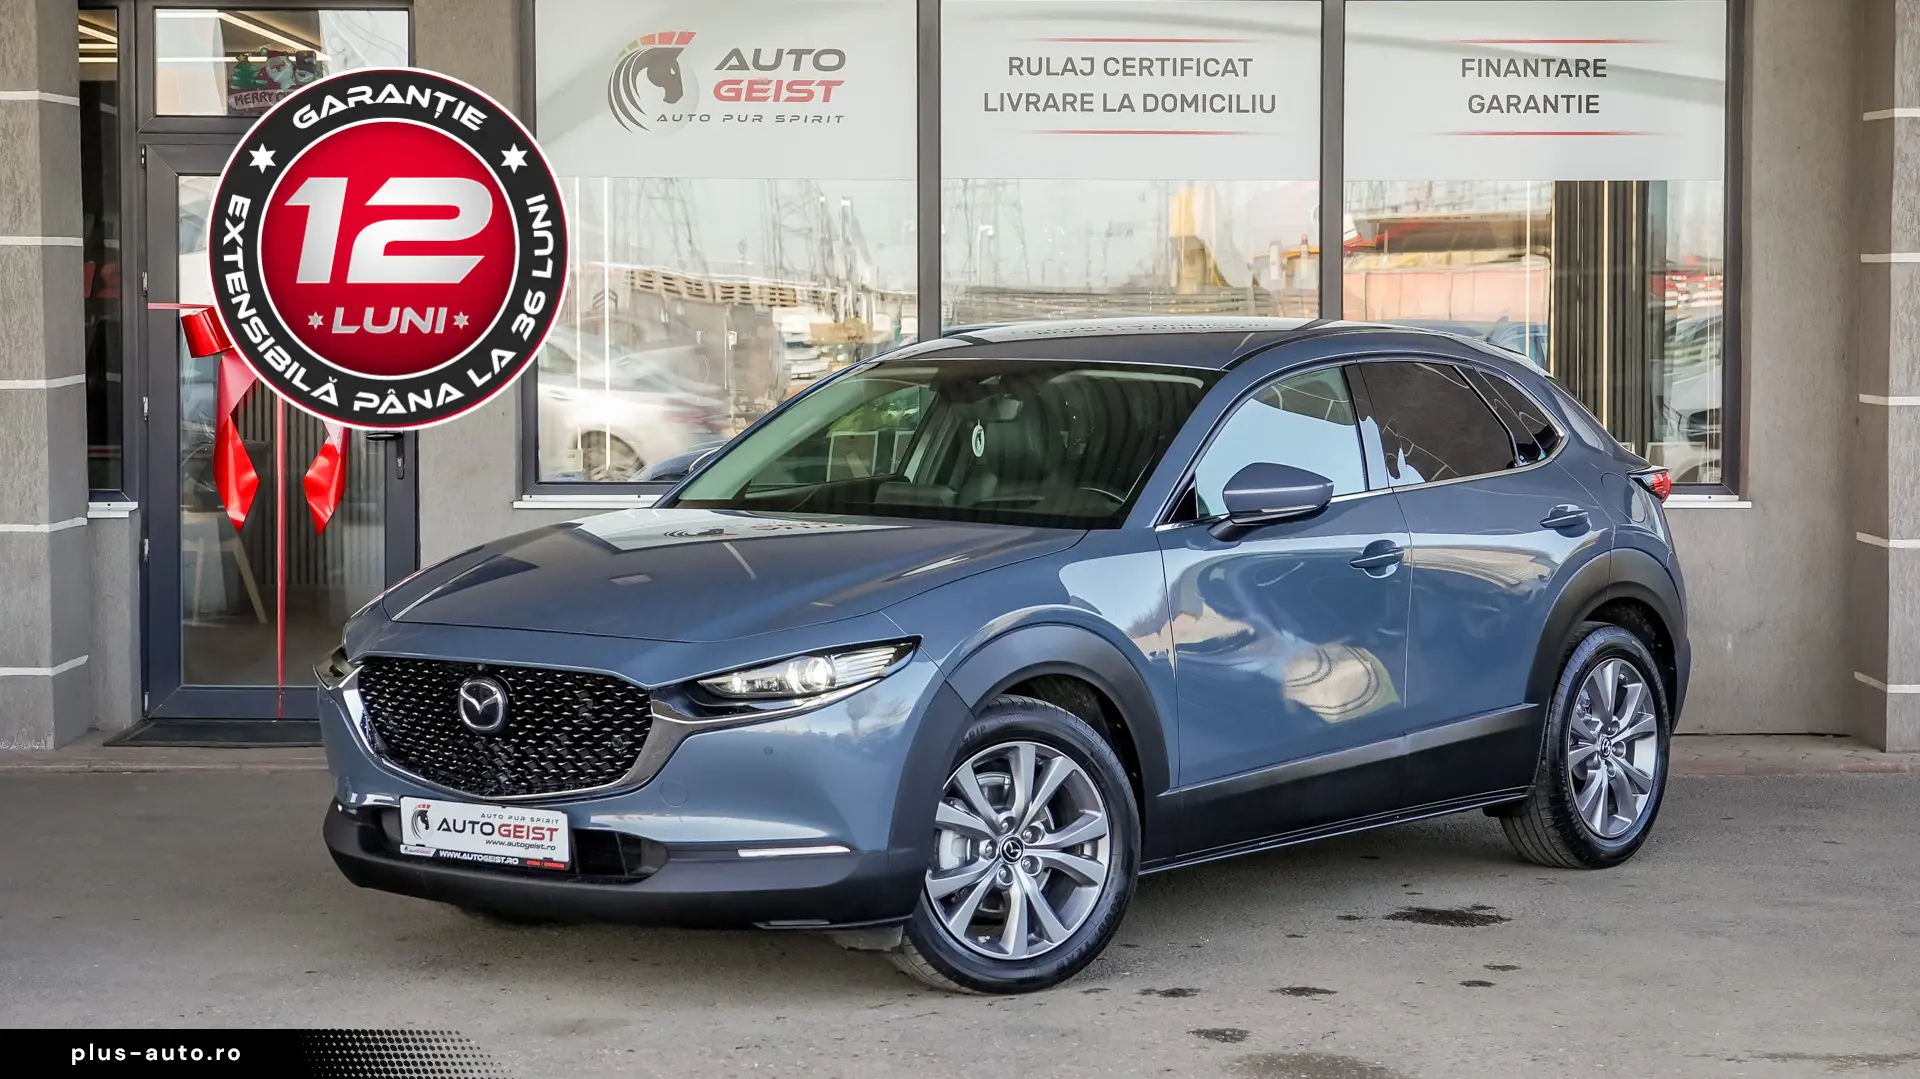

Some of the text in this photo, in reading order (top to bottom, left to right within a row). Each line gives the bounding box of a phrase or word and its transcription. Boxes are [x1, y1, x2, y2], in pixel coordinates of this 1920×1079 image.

[714, 47, 846, 72] AUTO
[1008, 56, 1253, 77] RULAJ CERTIFICAT
[1461, 58, 1607, 78] FINANTARE
[234, 91, 273, 106] MERRY
[713, 79, 846, 103] GEIST
[984, 92, 1276, 114] LIVRARE LA DOMICILIU
[1468, 94, 1600, 114] GARANTIE
[656, 113, 845, 124] AUTO PUR SPIRIT
[485, 839, 556, 851] www.autogeist.ro
[439, 850, 519, 865] WWW.AUTOGEIST.RO
